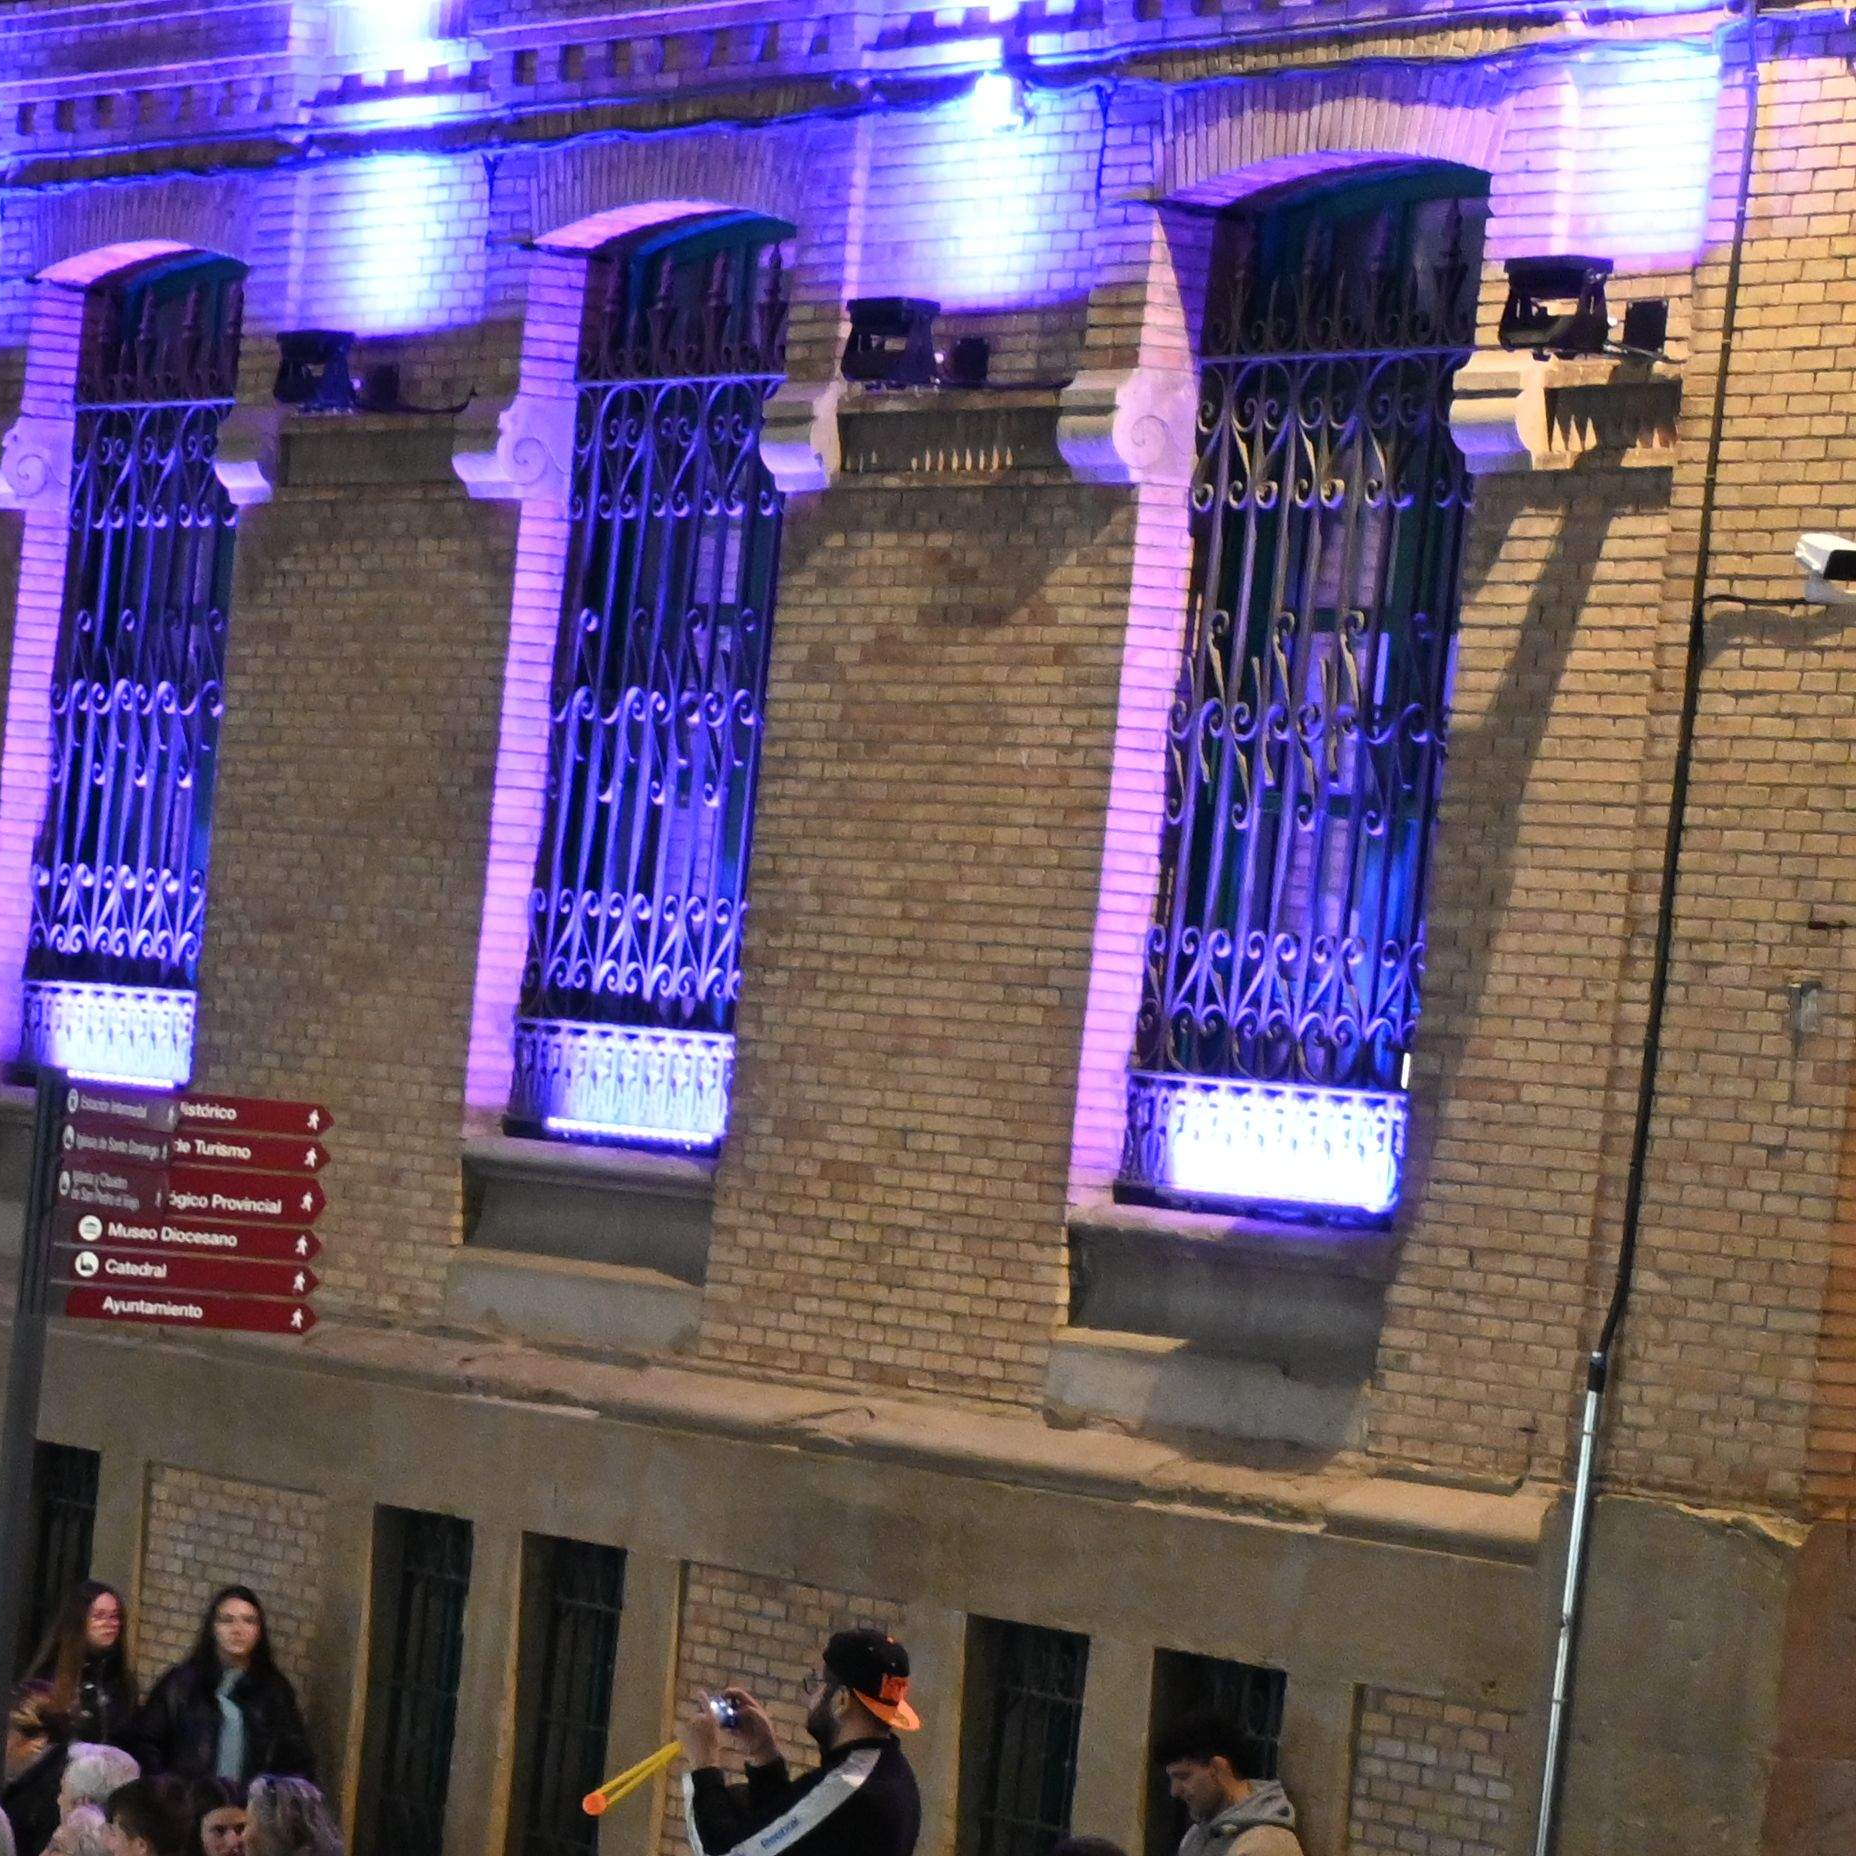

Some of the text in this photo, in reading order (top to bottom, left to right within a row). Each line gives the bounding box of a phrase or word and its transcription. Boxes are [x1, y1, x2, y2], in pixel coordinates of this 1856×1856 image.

[194, 1139, 252, 1159] Turismo
[211, 1194, 283, 1214] Provincial
[108, 1222, 238, 1248] Museo Diocesano
[105, 1258, 168, 1278] Catedral
[103, 1296, 204, 1319] Ayuntamiento
